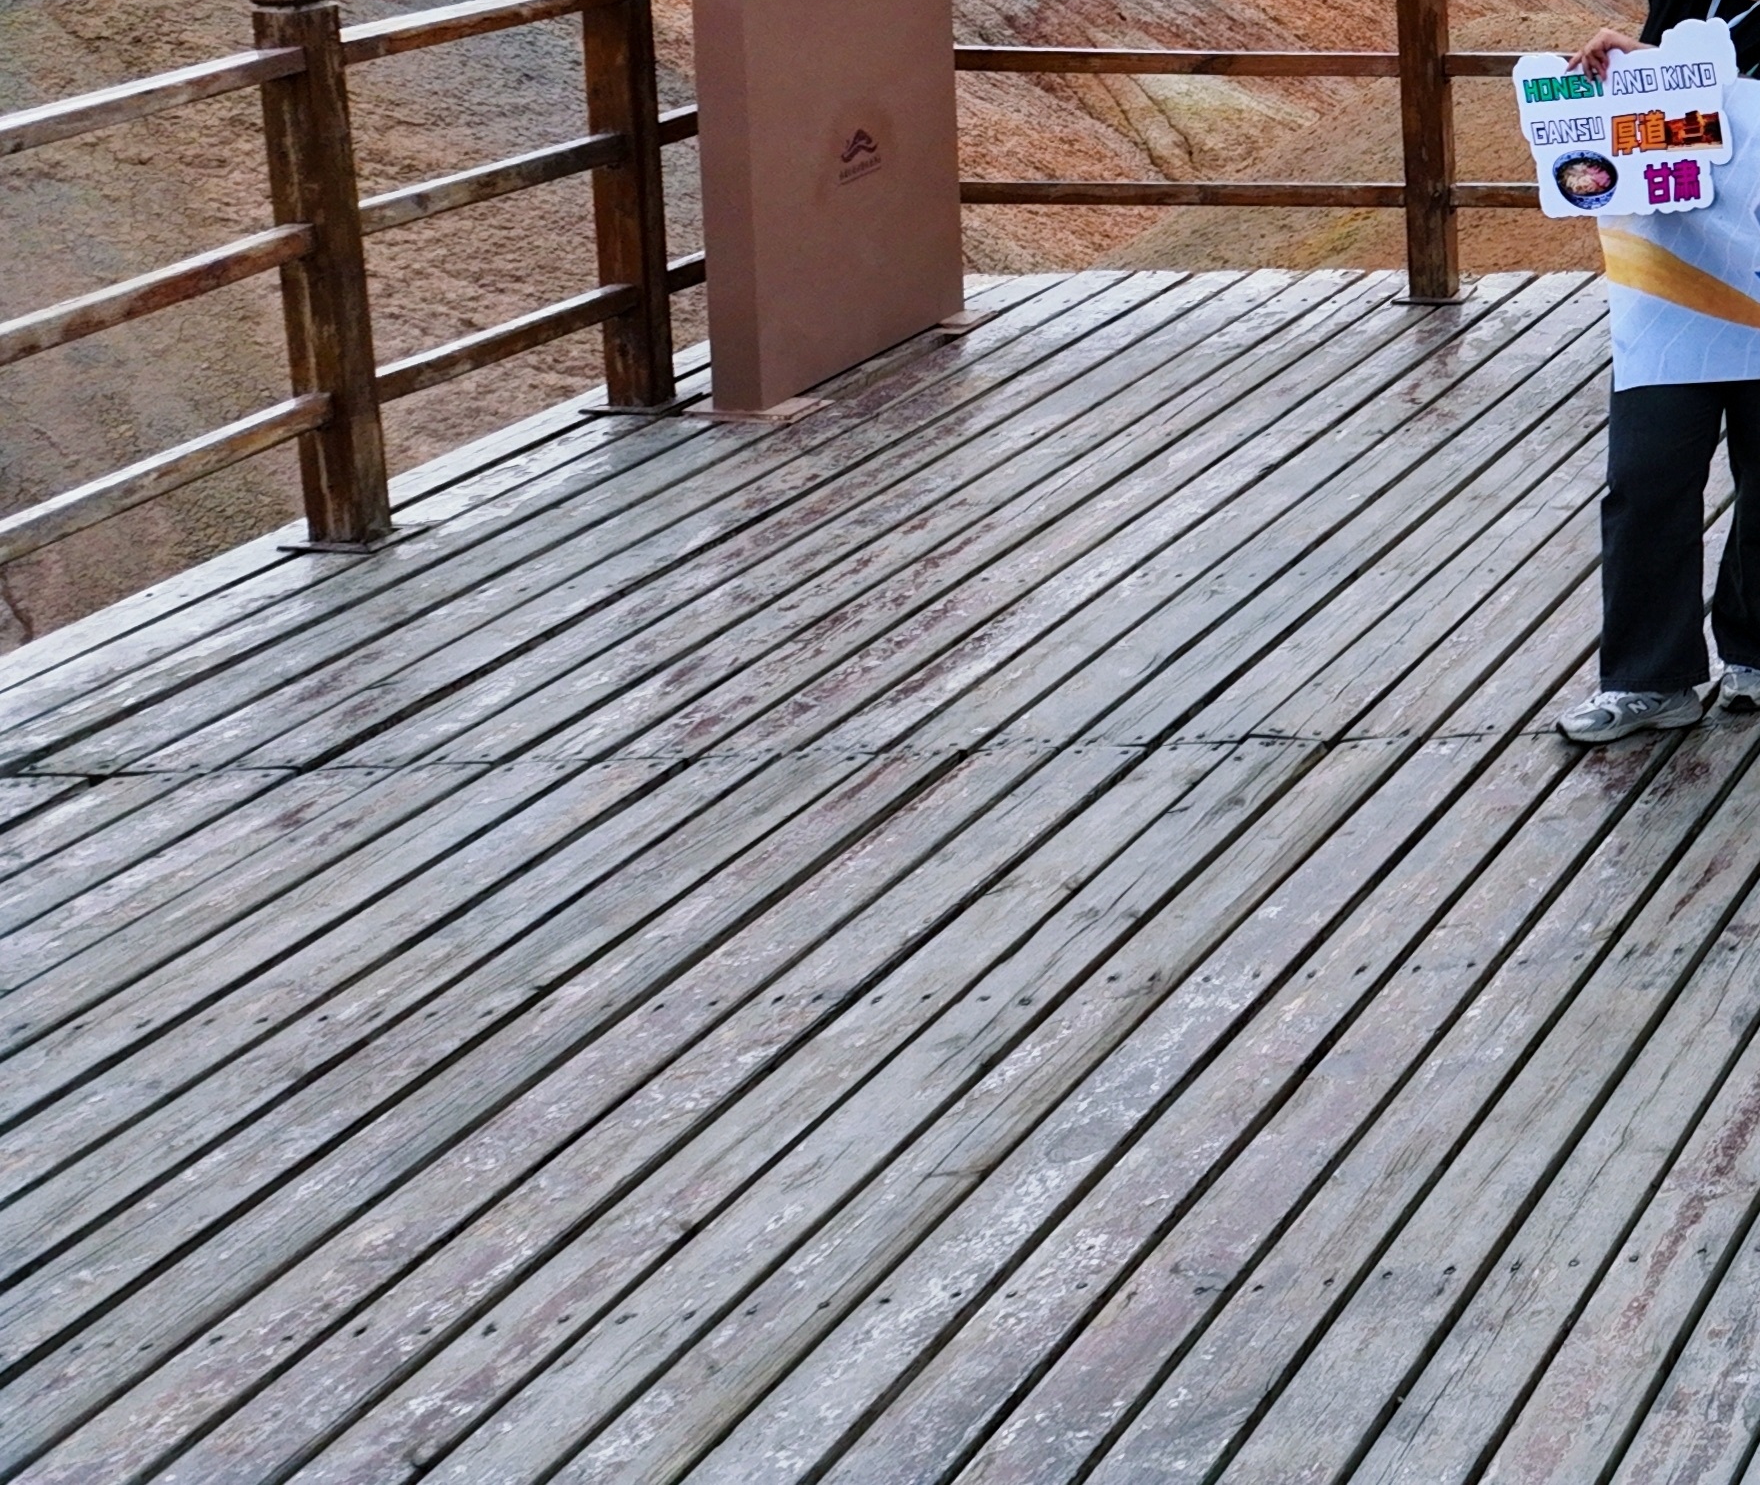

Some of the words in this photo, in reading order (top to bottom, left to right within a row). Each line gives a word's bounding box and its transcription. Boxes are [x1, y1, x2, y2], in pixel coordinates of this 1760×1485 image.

[1611, 67, 1658, 96] AND
[1662, 62, 1717, 92] KIND
[1530, 116, 1606, 146] GANSU
[1611, 109, 1669, 157] 厚道
